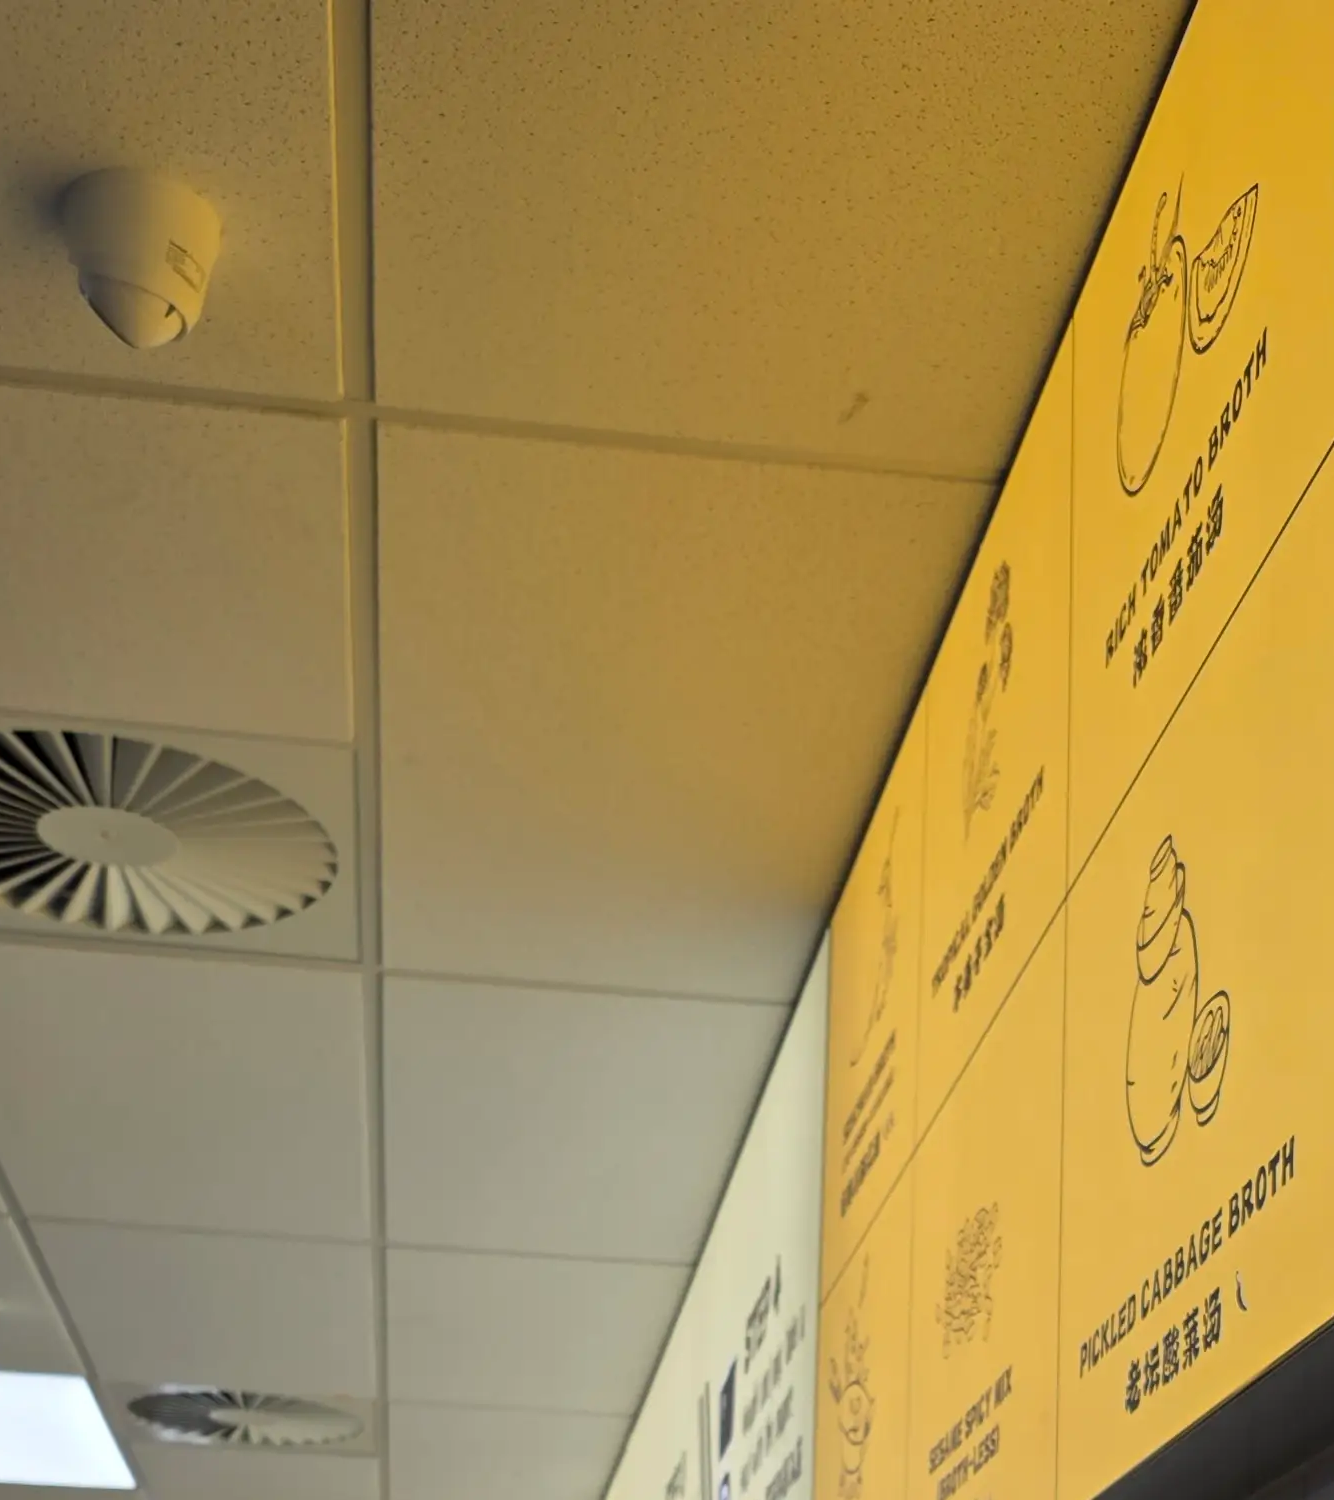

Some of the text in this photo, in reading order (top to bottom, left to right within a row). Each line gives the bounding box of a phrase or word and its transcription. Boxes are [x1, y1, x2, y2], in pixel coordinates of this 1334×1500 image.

[1105, 326, 1267, 668] RICH TOMATO BROTH
[1079, 1134, 1295, 1379] PICKLED CABBAGE BROTH
